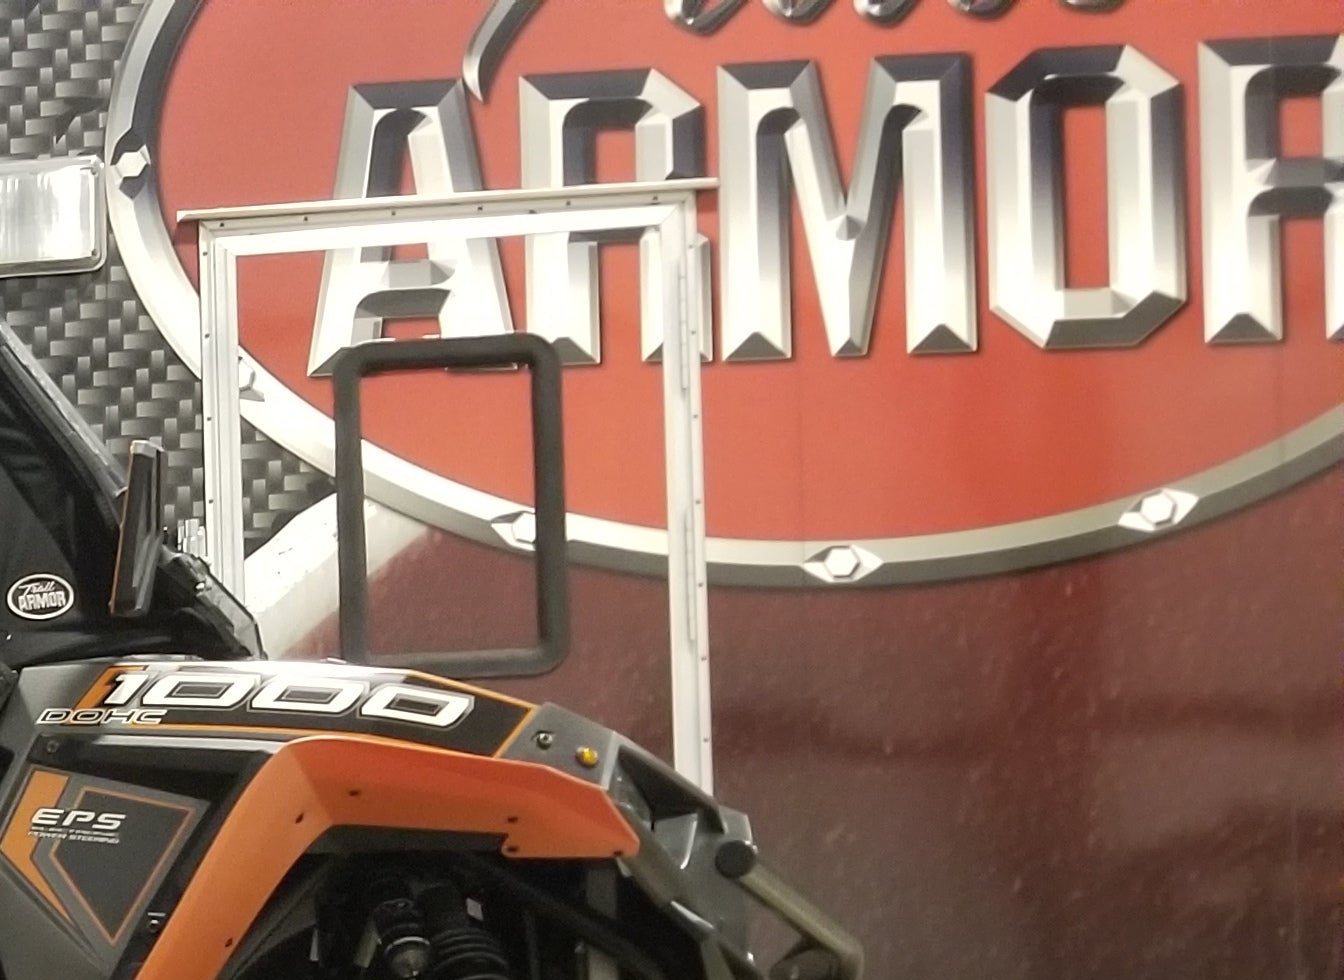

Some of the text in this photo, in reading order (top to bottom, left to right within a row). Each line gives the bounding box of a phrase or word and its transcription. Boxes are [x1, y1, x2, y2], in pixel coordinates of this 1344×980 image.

[308, 35, 1344, 376] ARMOR
[18, 590, 66, 611] ARMOR
[103, 670, 475, 729] 1000
[35, 707, 168, 726] DOHC
[31, 807, 127, 830] EPS
